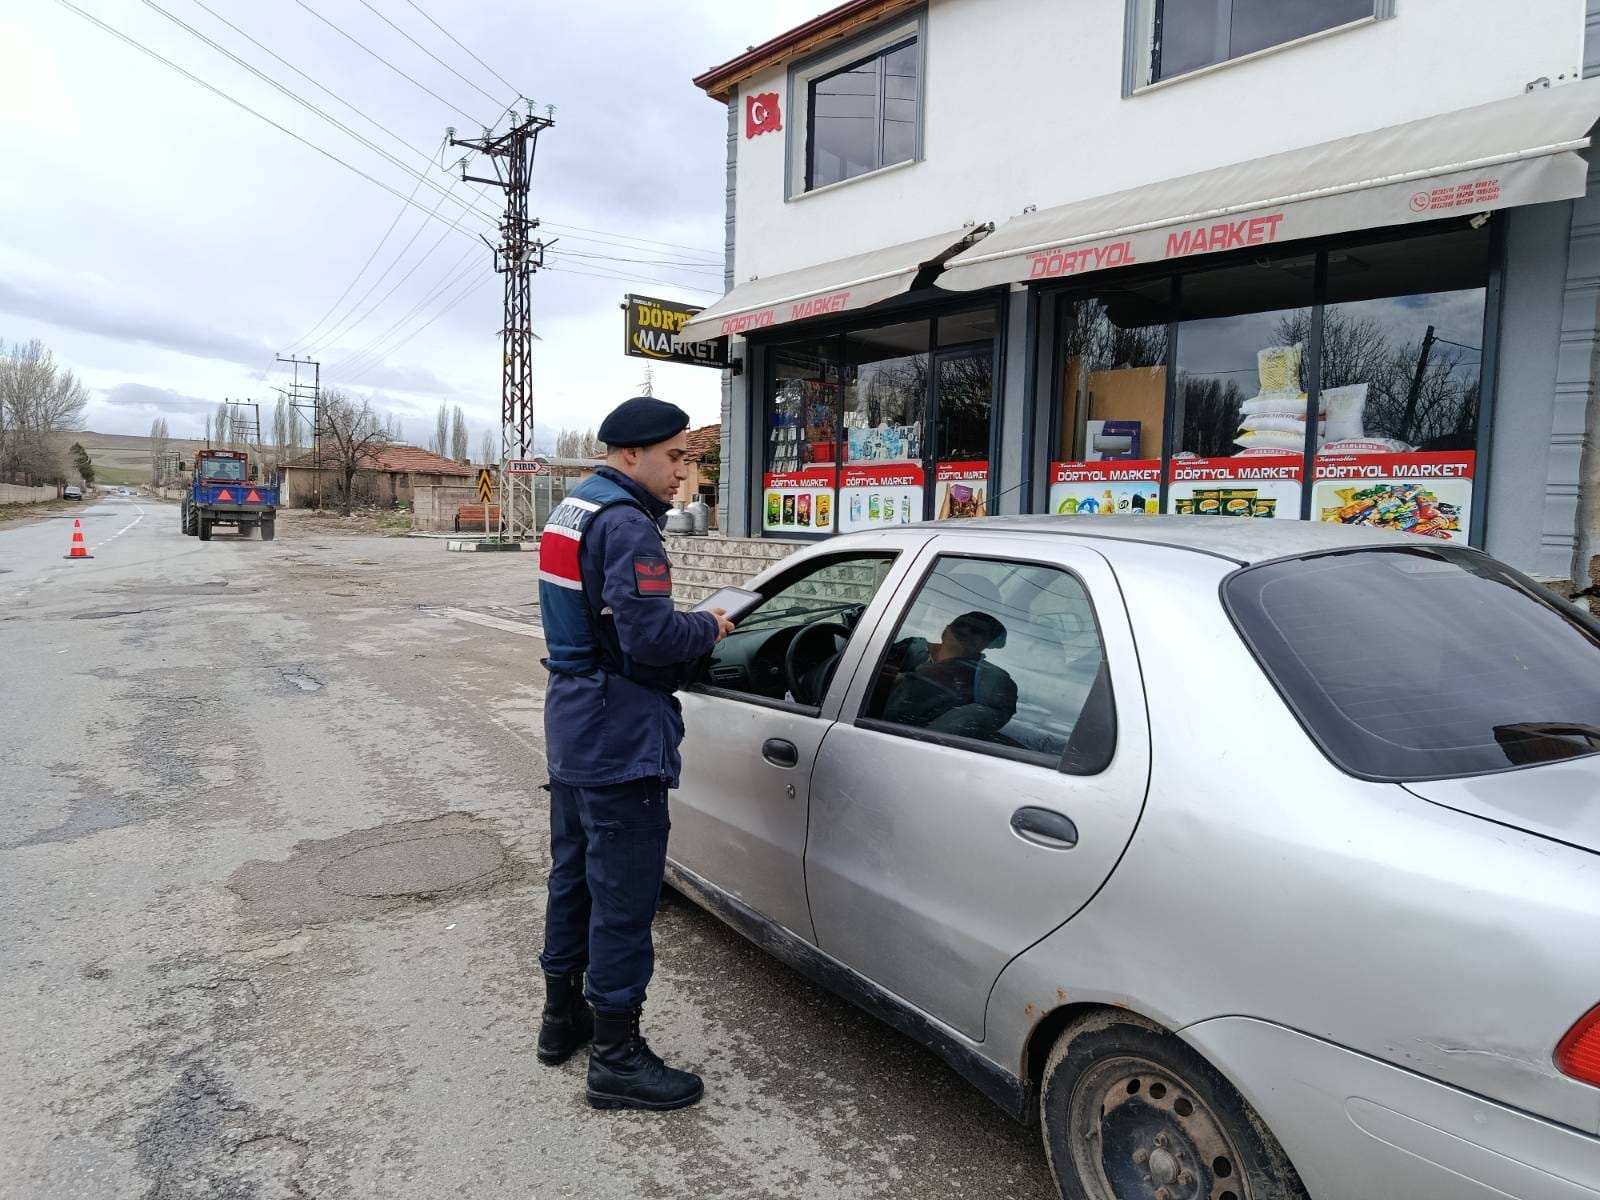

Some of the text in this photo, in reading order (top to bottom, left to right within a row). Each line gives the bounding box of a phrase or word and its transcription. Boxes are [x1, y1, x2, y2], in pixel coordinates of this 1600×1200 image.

[1165, 213, 1284, 257] MARKET
[791, 292, 850, 320] MARKET
[938, 470, 988, 480] DÖRTYOL MARKET
[1057, 469, 1161, 481] DÖRTYOL MARKET
[1175, 466, 1300, 480] DÖRTYOL MARKET
[1316, 463, 1468, 478] DÖRTYOL MARKET
[770, 478, 829, 487] DÖRTYOL MARKET
[845, 476, 915, 486] DÖRTYOL MARKET
